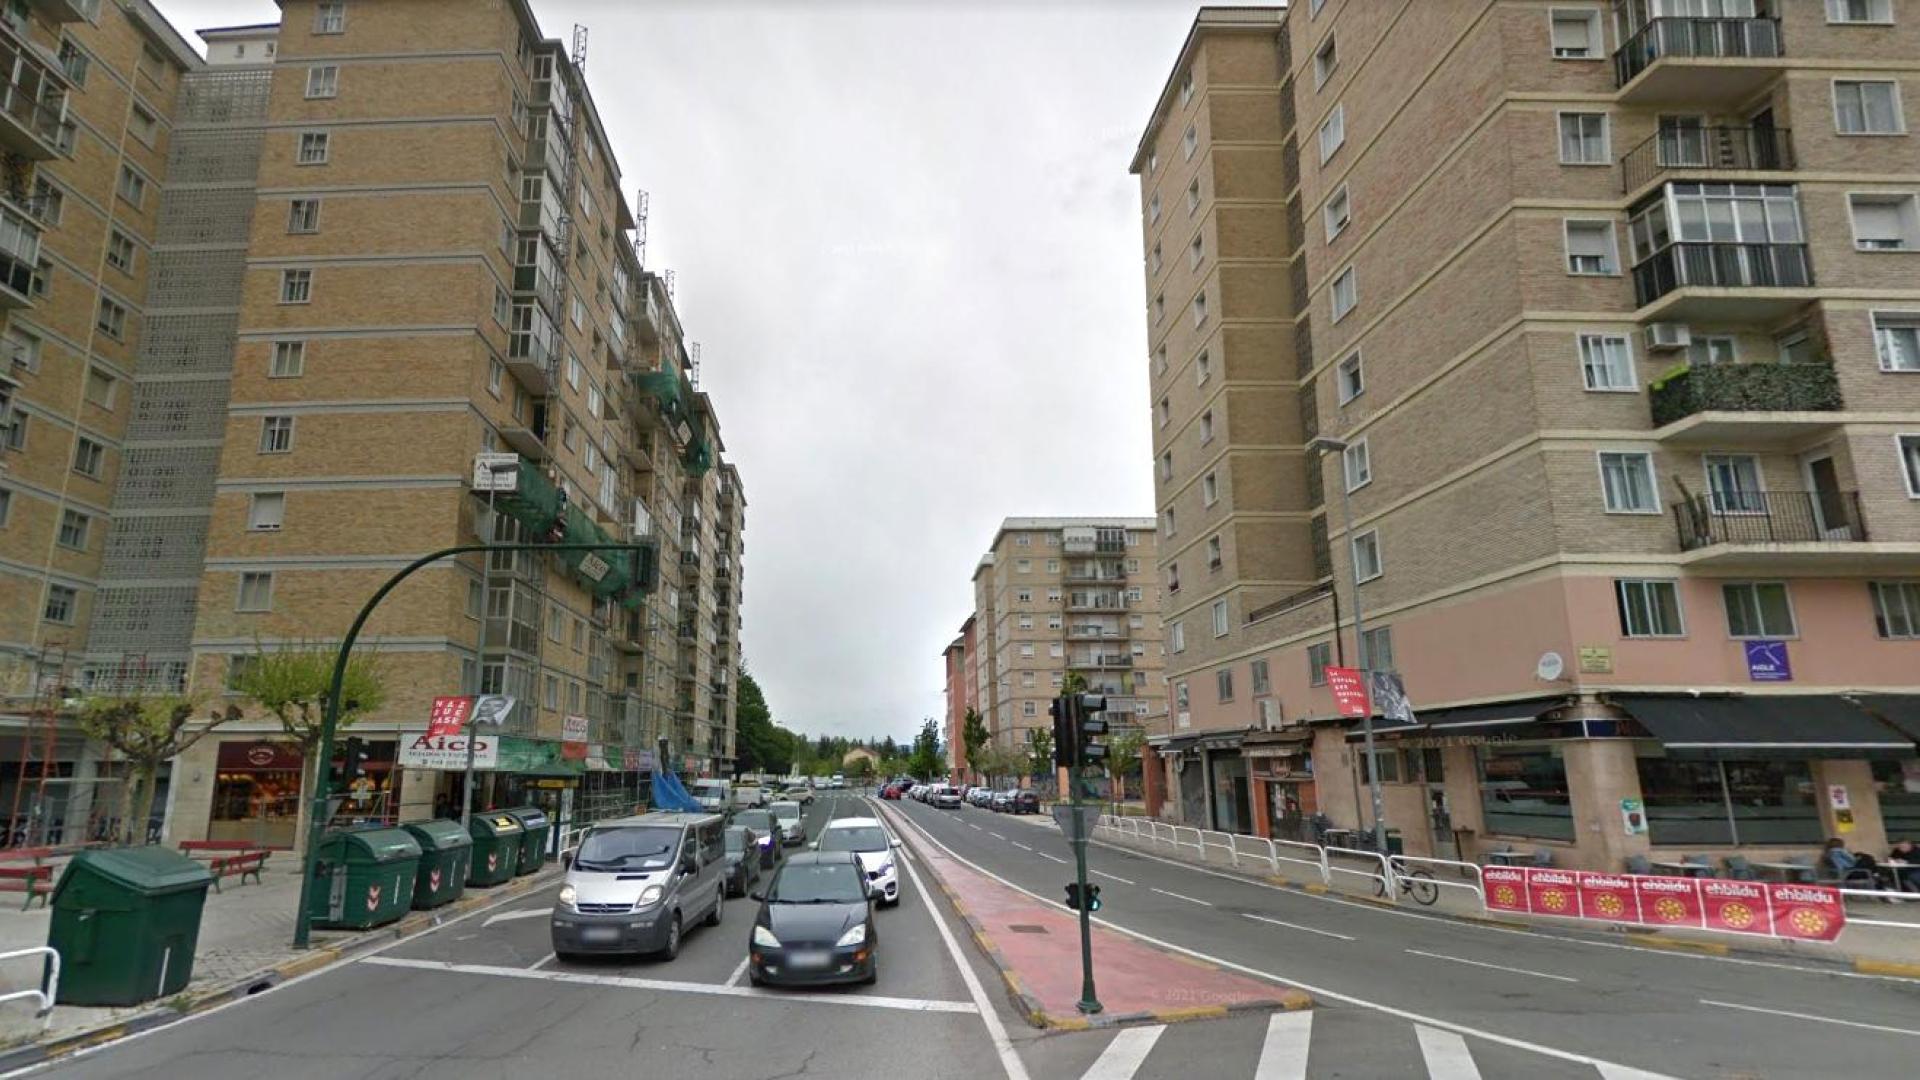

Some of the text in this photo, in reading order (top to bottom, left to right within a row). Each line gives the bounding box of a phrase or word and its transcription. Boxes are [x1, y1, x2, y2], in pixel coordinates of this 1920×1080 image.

[409, 736, 487, 751] Aico
[1532, 873, 1572, 885] ehbildu
[1642, 880, 1690, 893] ehbildu
[1706, 883, 1759, 898] ehbildu
[1776, 887, 1834, 903] ehbildu
